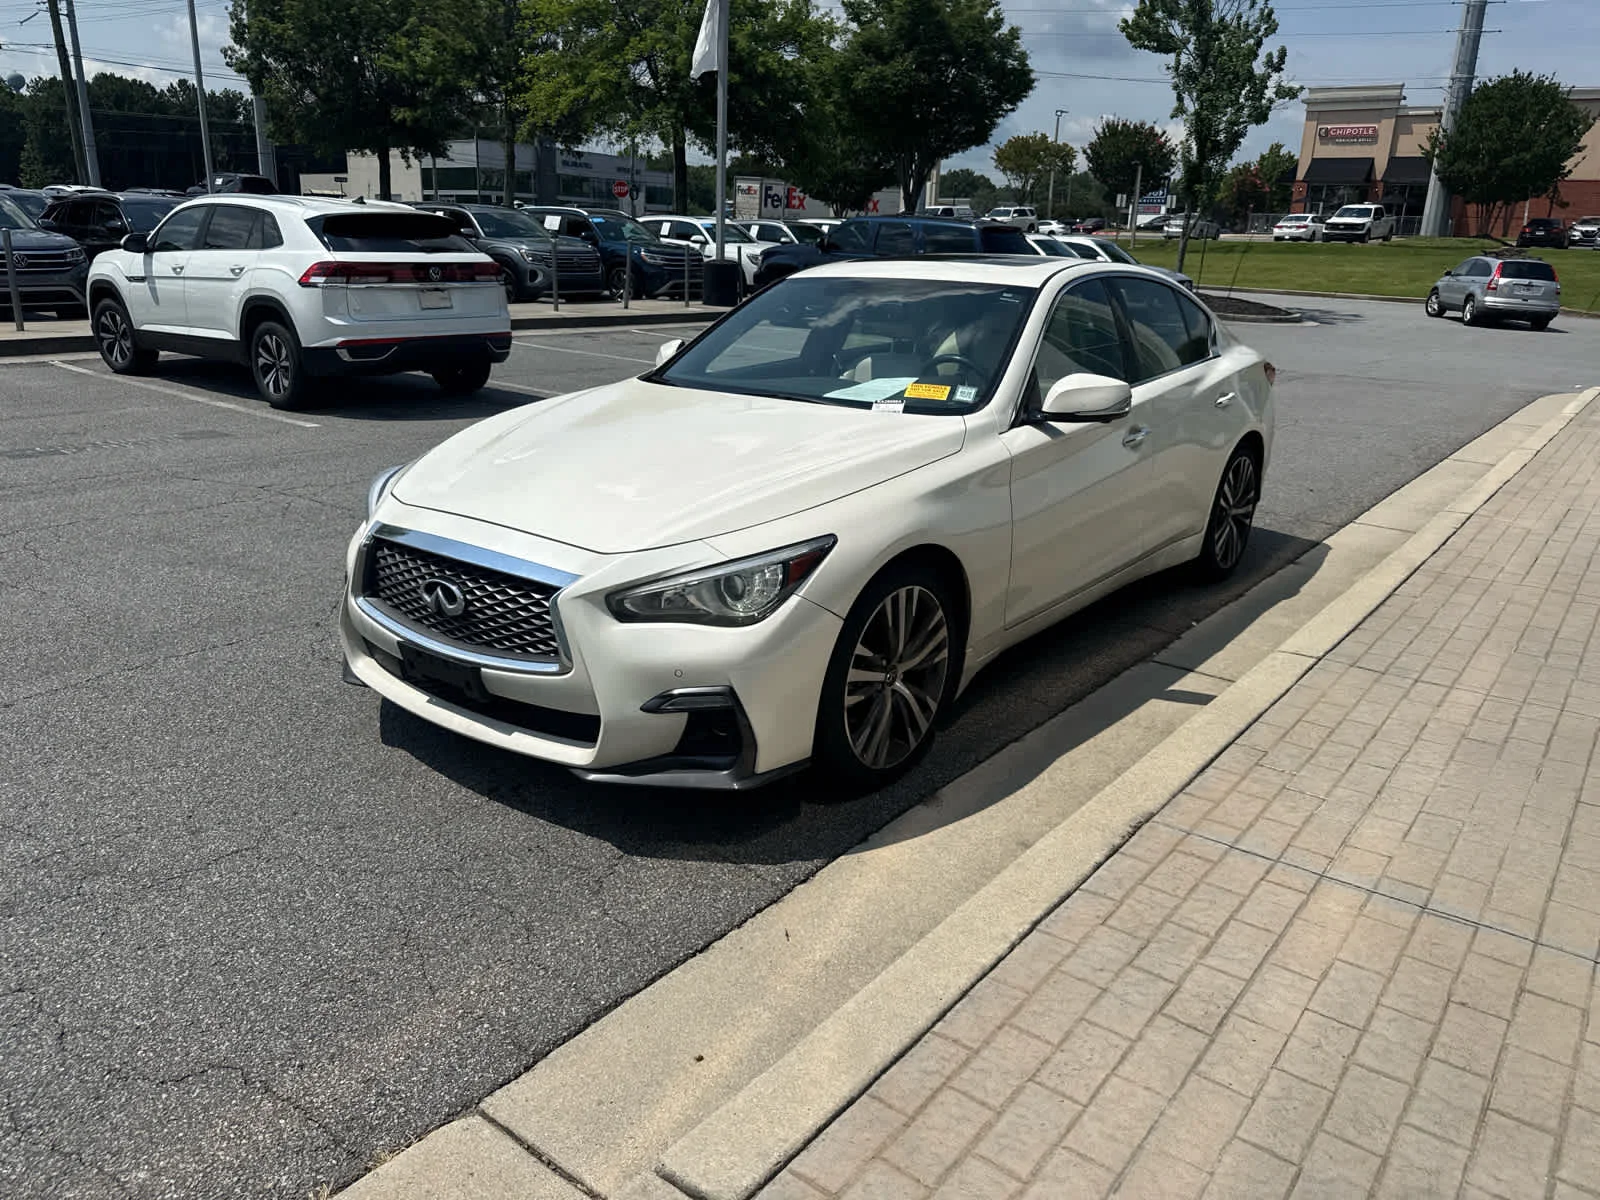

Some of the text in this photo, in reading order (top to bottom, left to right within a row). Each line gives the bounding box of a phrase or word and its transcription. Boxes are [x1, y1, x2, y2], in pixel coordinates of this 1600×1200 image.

[1330, 127, 1375, 136] CHIPOTLE
[614, 185, 628, 193] STOP
[737, 184, 758, 195] FedEx
[764, 186, 807, 210] FedEx
